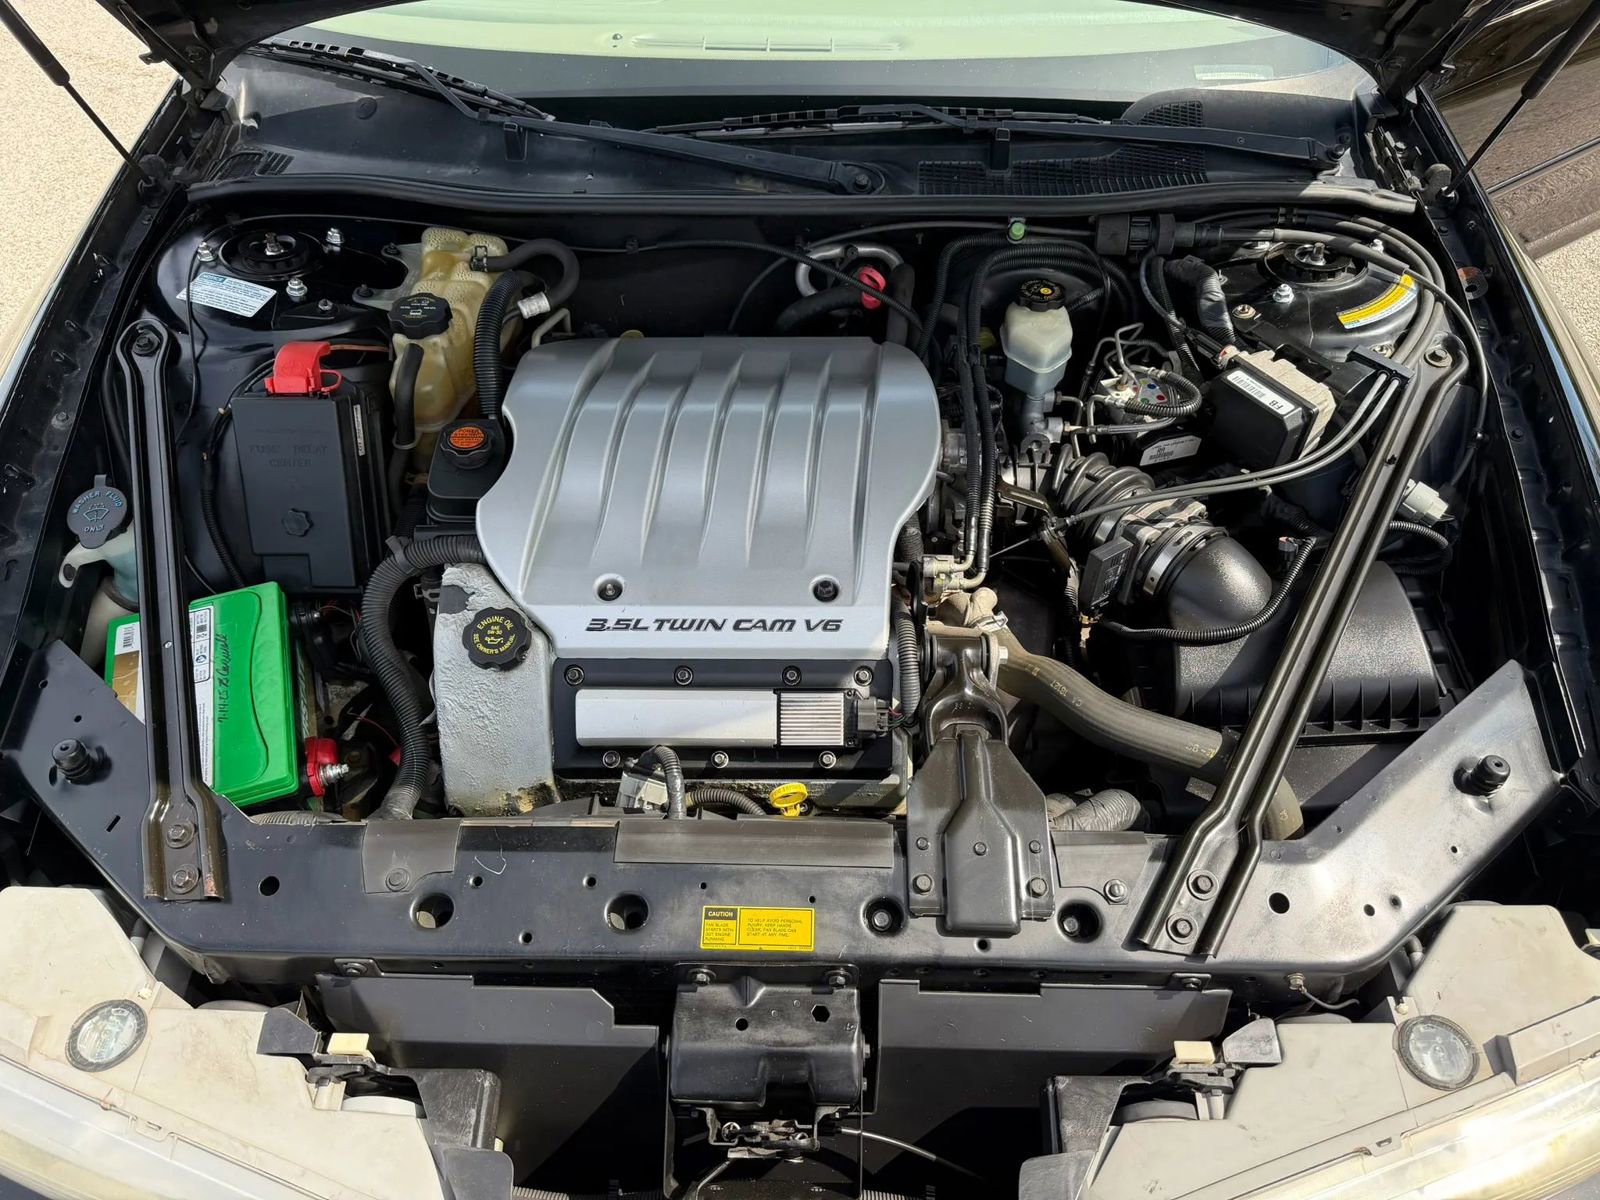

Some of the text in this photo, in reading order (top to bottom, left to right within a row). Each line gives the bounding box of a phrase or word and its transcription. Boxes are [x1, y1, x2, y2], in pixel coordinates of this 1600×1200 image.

[72, 490, 123, 514] WASHER FLUID
[84, 524, 105, 532] ONLY
[477, 616, 514, 630] ENGINE OIL
[585, 618, 844, 632] 3.5L TWIN CAM V6
[476, 643, 499, 655] OWNER'S
[499, 633, 516, 652] MANUAL
[707, 910, 733, 918] CAUTION
